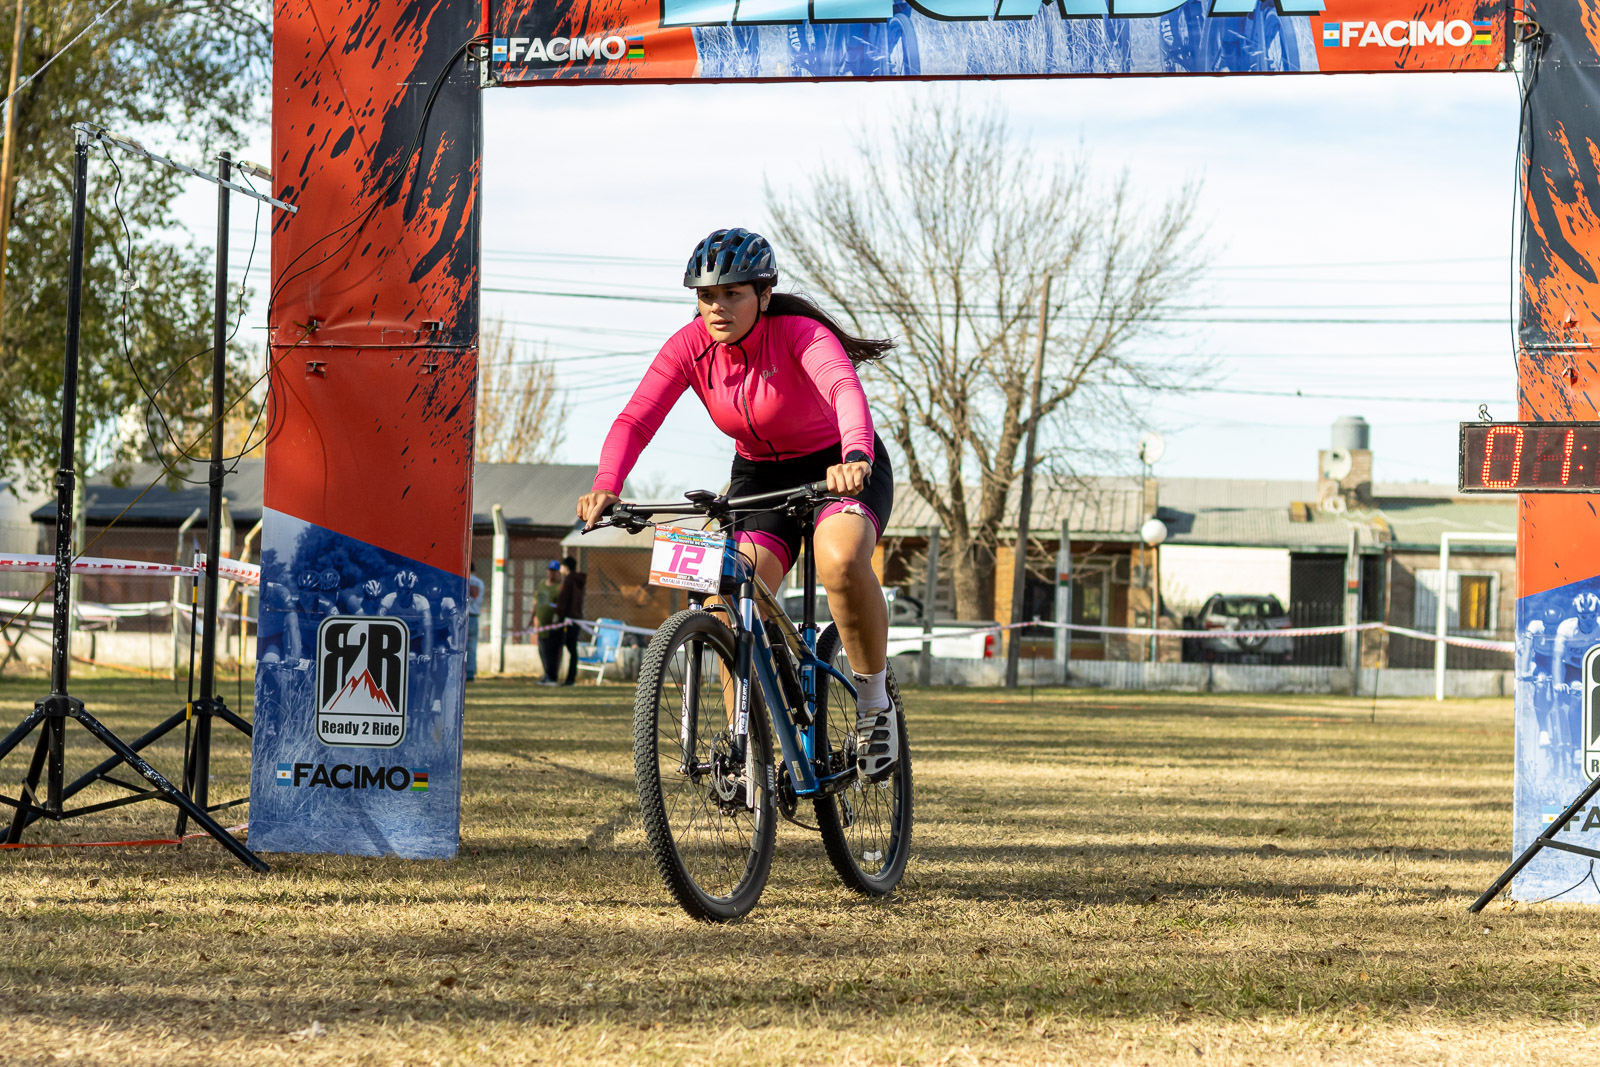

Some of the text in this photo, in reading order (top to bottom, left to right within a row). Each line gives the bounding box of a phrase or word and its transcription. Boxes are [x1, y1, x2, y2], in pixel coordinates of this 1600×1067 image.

[1341, 20, 1472, 48] FACIMO
[508, 36, 627, 62] FACIMO
[668, 544, 706, 576] 12
[321, 720, 399, 736] Ready 2 Ride
[293, 763, 411, 791] FACIMO
